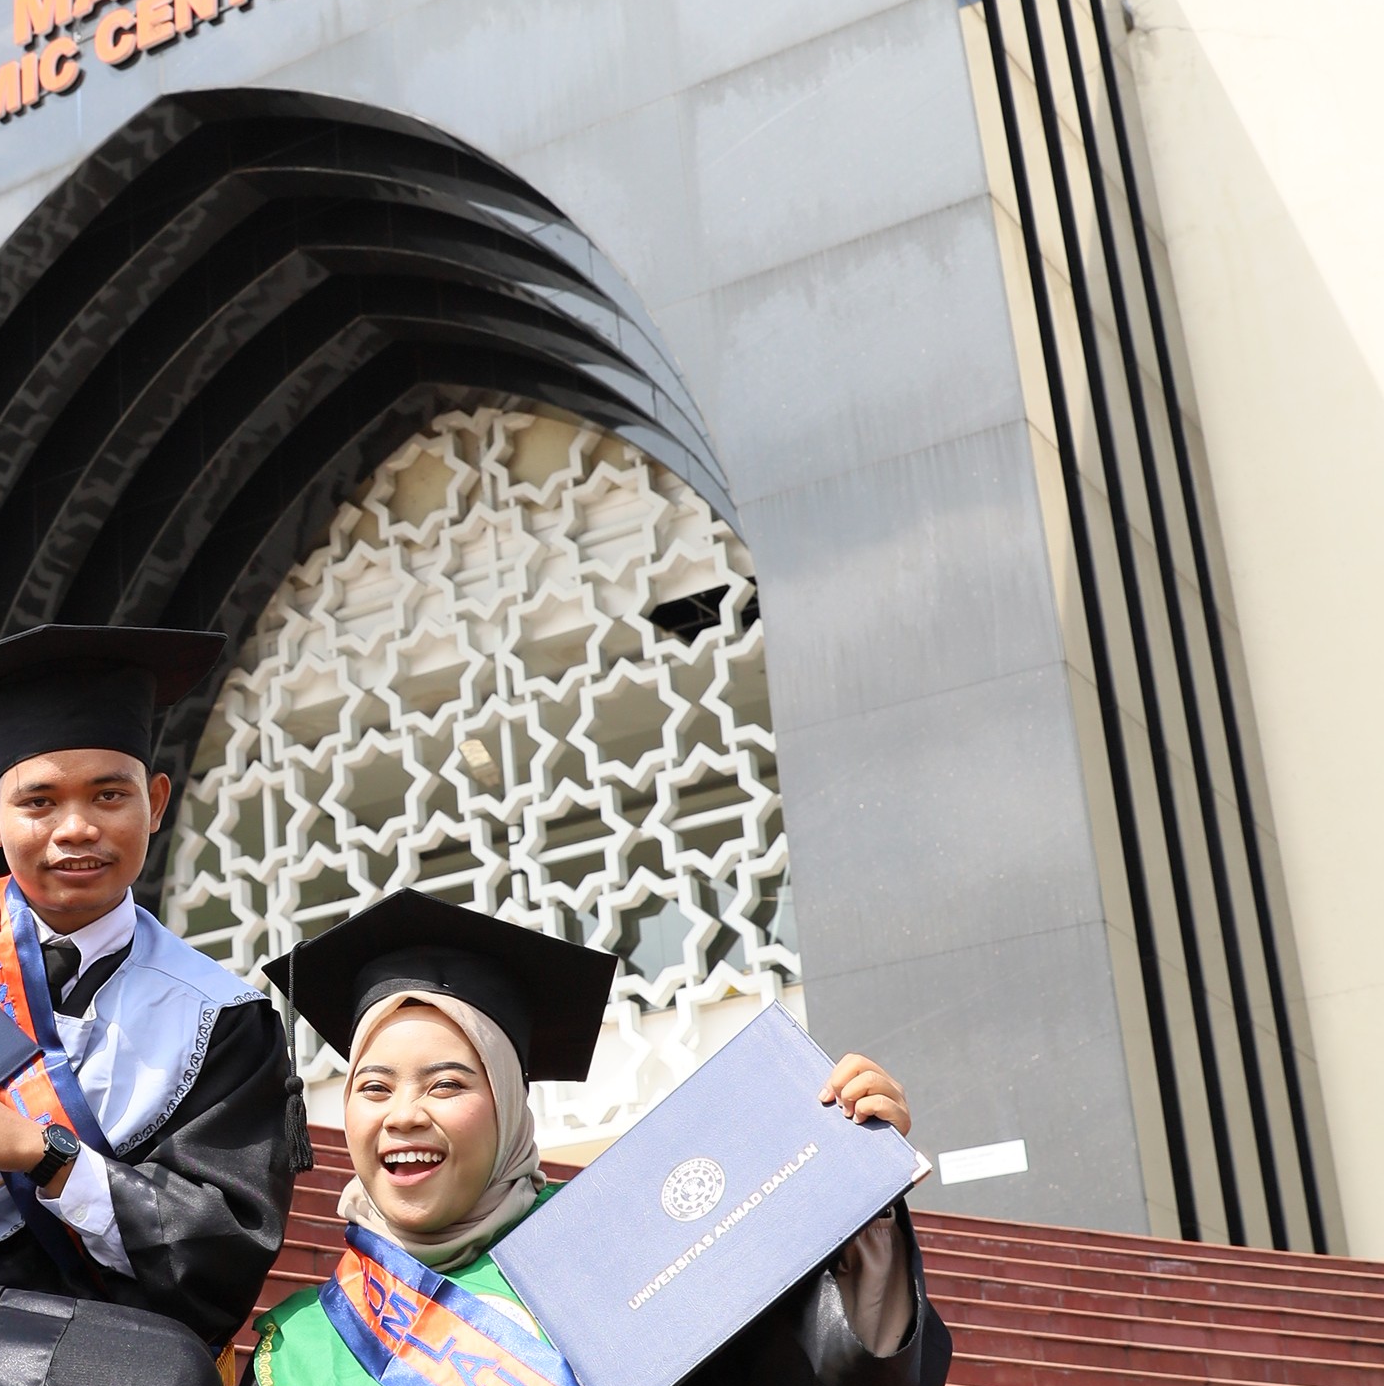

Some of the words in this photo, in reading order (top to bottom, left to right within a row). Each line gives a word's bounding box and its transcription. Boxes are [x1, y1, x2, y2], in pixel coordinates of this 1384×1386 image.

[627, 1233, 715, 1310] UNIVERSITAS
[714, 1192, 763, 1239] AHMAD
[760, 1142, 820, 1196] DAHLAN
